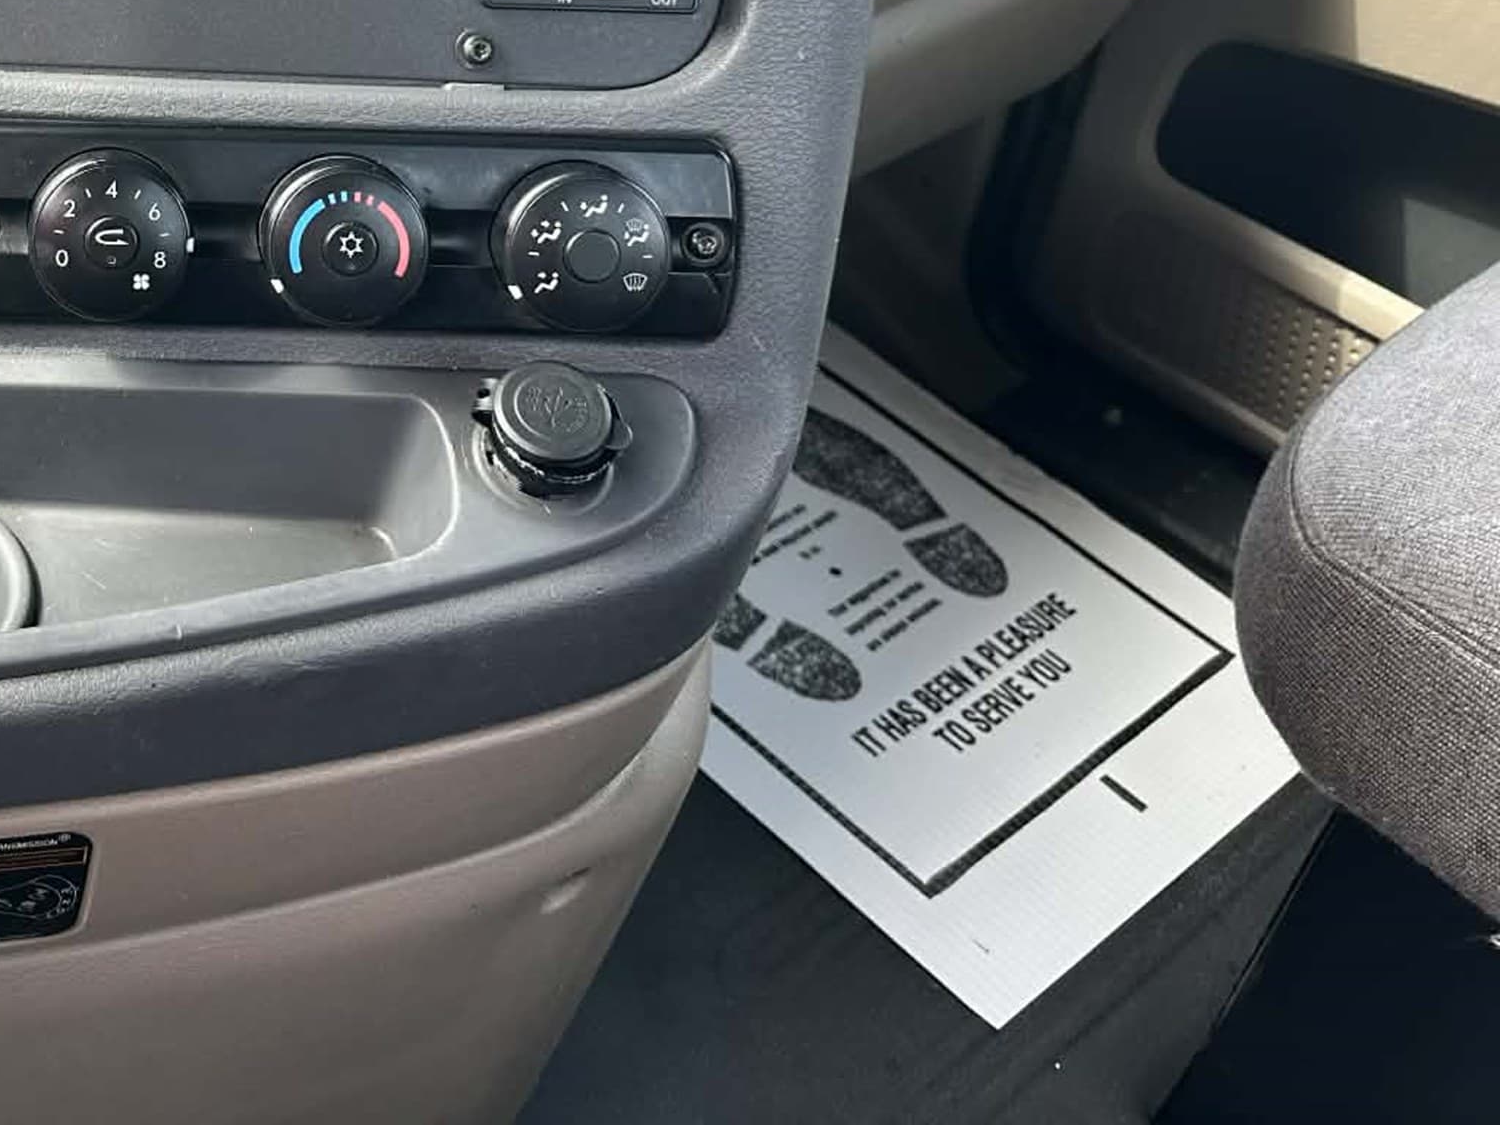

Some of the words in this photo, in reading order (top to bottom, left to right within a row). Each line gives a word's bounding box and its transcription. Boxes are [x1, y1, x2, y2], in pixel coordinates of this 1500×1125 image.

[105, 180, 118, 198] 4
[63, 201, 76, 218] 2
[148, 203, 161, 220] 6
[55, 250, 69, 267] 0
[153, 251, 166, 269] 8
[975, 593, 1077, 668] PLEASURE
[961, 655, 993, 681] A
[912, 665, 976, 714] BEEN
[932, 720, 976, 752] TO
[961, 677, 1035, 733] SERVE
[1017, 648, 1072, 689] YOU
[872, 699, 928, 742] HAS
[852, 727, 887, 757] IT
